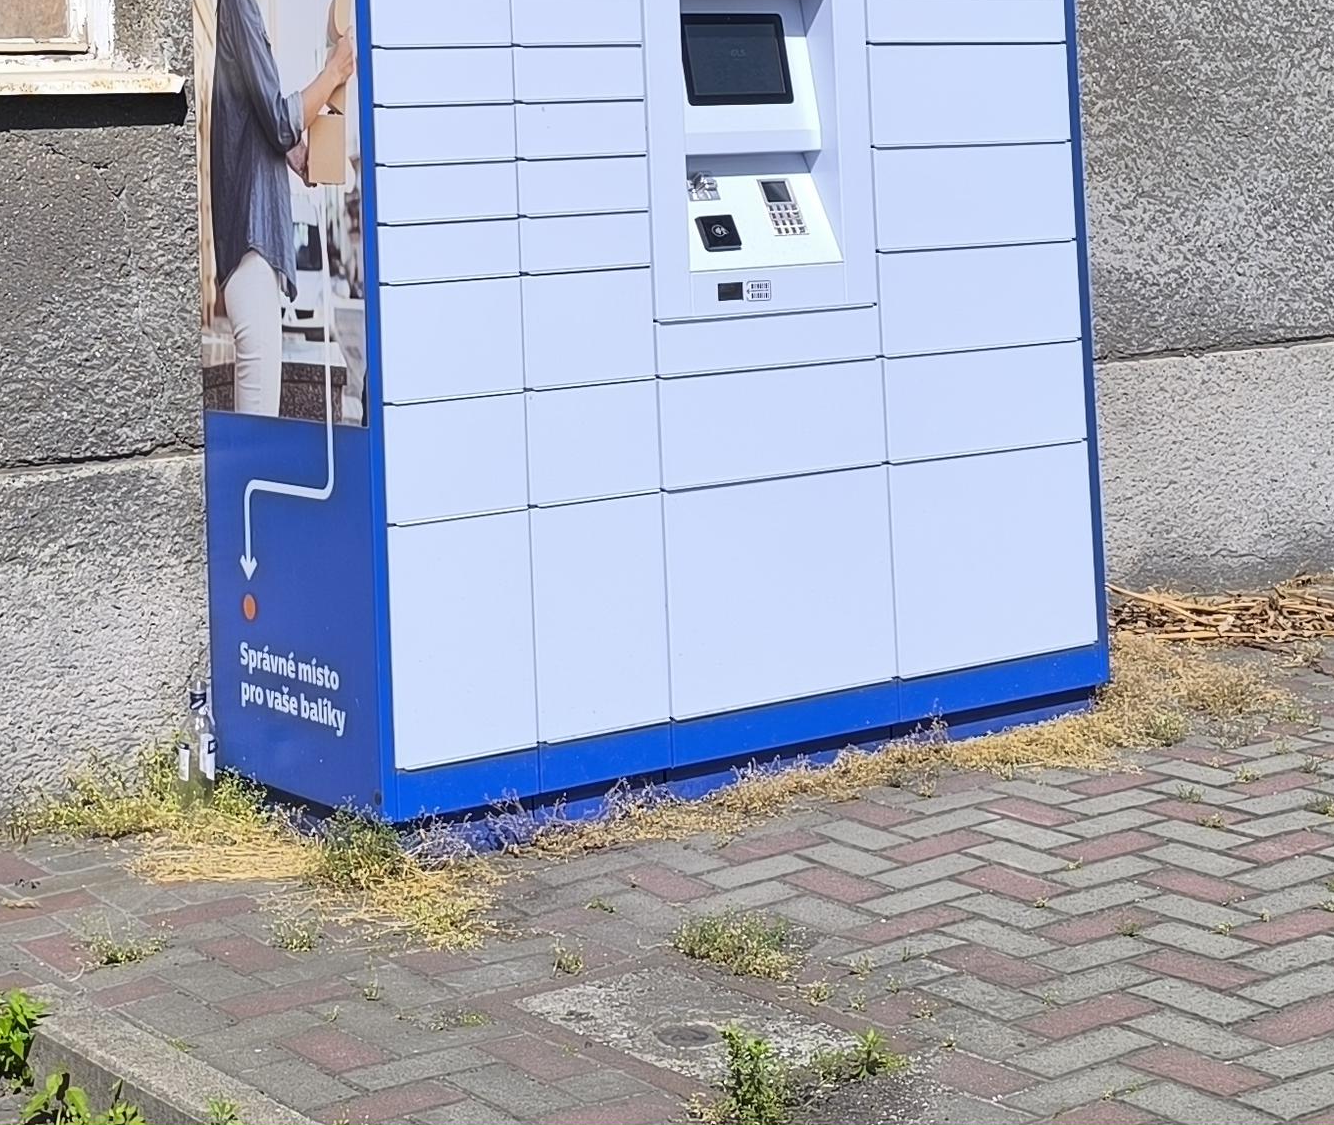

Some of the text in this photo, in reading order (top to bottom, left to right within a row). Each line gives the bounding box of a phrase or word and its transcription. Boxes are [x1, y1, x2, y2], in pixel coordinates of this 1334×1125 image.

[239, 641, 340, 691] Správné místo
[241, 681, 347, 737] pro vaše balíky
